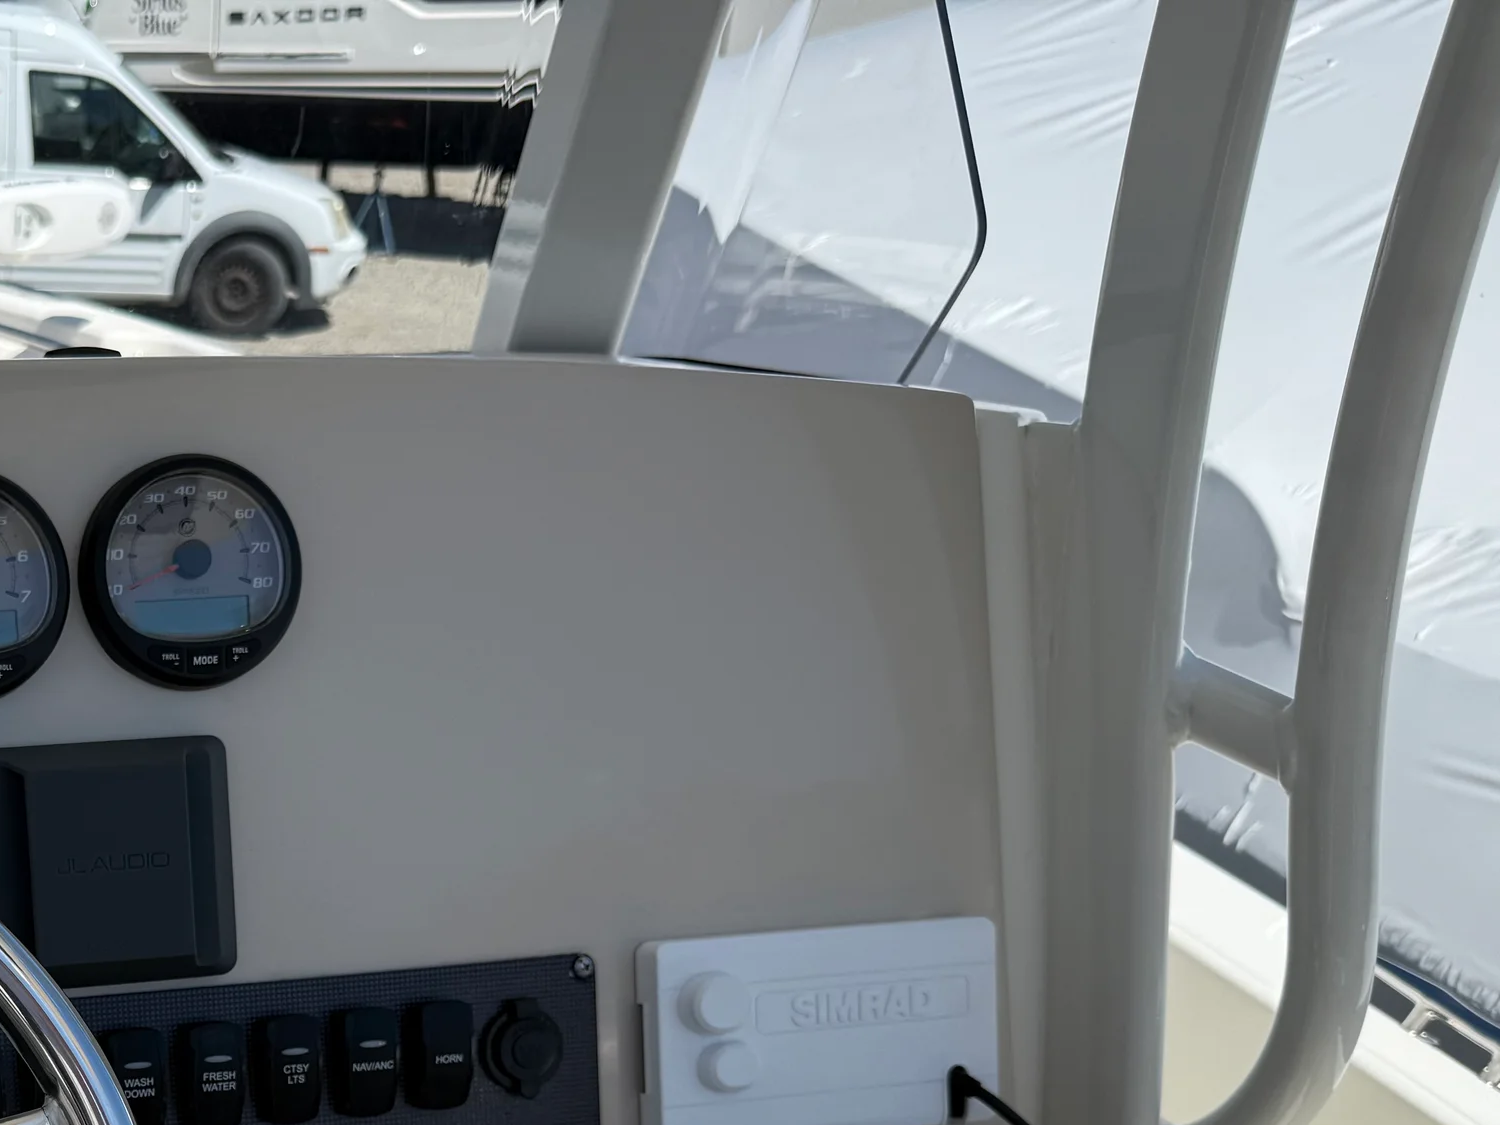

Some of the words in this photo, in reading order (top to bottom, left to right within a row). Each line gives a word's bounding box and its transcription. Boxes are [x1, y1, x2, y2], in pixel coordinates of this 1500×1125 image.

[174, 486, 196, 495] 40
[207, 490, 228, 500] 50
[144, 493, 164, 503] 30
[235, 508, 255, 519] 60
[119, 514, 137, 525] 20
[250, 542, 270, 554] 70
[17, 550, 29, 562] 6
[253, 577, 273, 588] 80
[20, 590, 32, 603] 7
[232, 646, 249, 654] TROLL
[162, 653, 180, 661] TROLL
[193, 655, 219, 666] MODE
[57, 857, 87, 875] JL
[90, 852, 170, 874] AUDIO
[790, 984, 933, 1028] SIMRAD
[435, 1053, 464, 1065] HORN
[283, 1063, 310, 1075] CTSY
[352, 1060, 395, 1072] NAV/ANC
[203, 1071, 237, 1082] FRESH
[287, 1074, 306, 1085] LTS
[124, 1077, 155, 1088] WASH
[202, 1081, 237, 1093] WATER
[125, 1088, 156, 1099] DOWN
